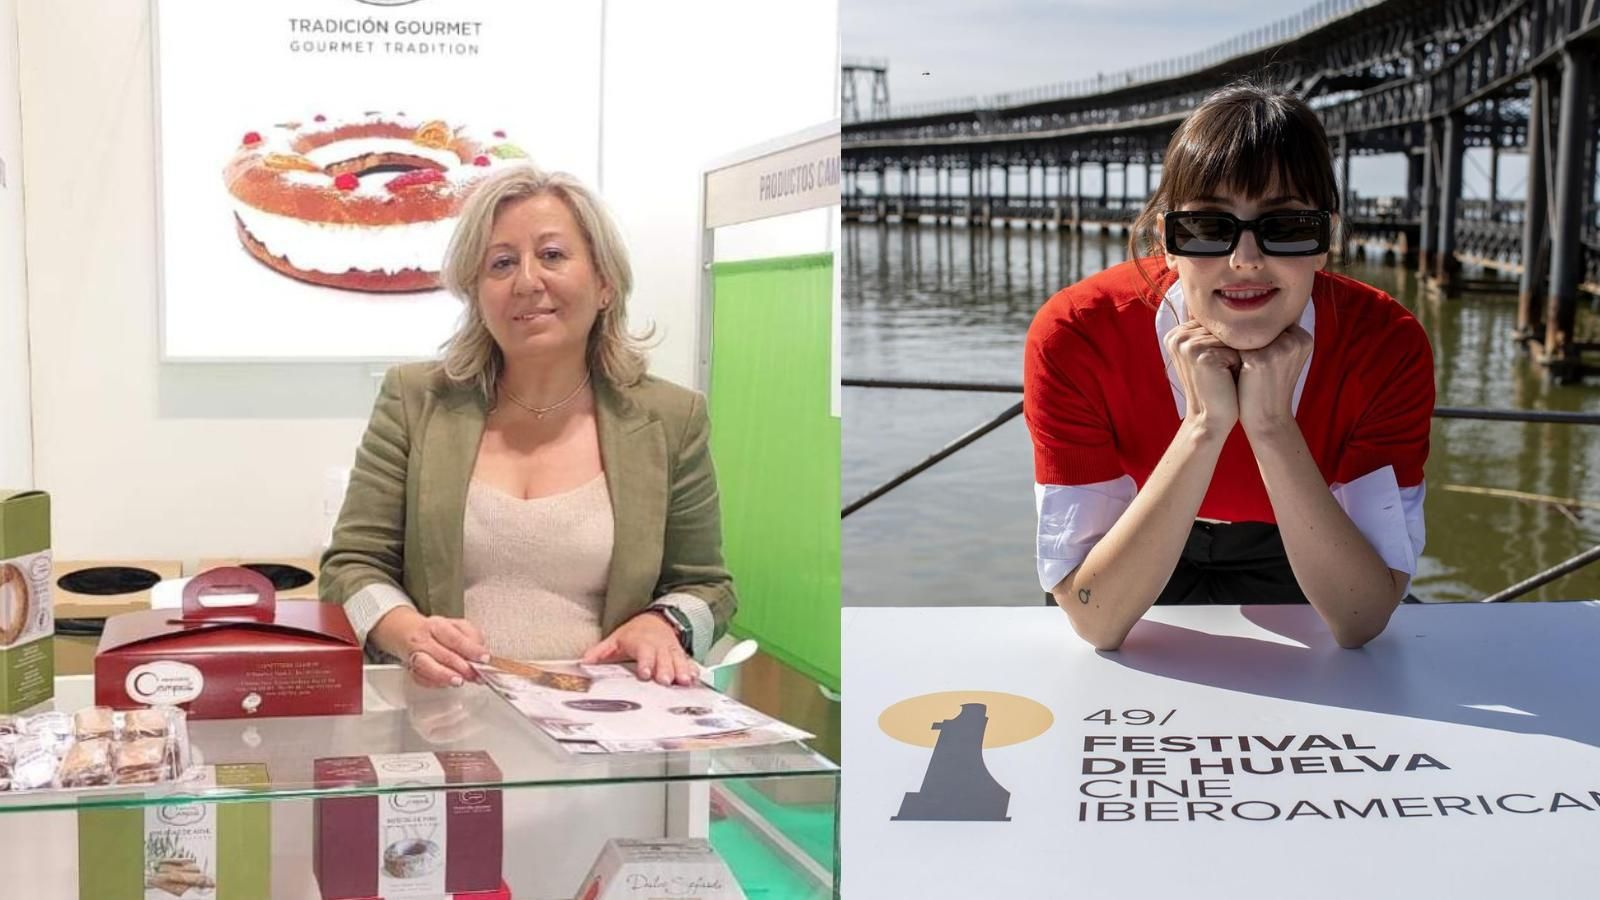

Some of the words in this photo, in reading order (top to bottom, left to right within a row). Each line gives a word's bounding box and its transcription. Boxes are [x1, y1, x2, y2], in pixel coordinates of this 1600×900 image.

[288, 16, 389, 34] TRADICIÓN
[394, 20, 482, 36] GOURMET
[289, 40, 374, 54] GOURMET
[384, 41, 480, 55] TRADITION
[760, 162, 815, 201] PRODUCTOS
[1083, 708, 1177, 726] 49/
[1083, 733, 1376, 753] FESTIVAL
[1082, 757, 1167, 775] DE
[1189, 753, 1452, 775] HUELVA
[1079, 779, 1233, 799] CINE
